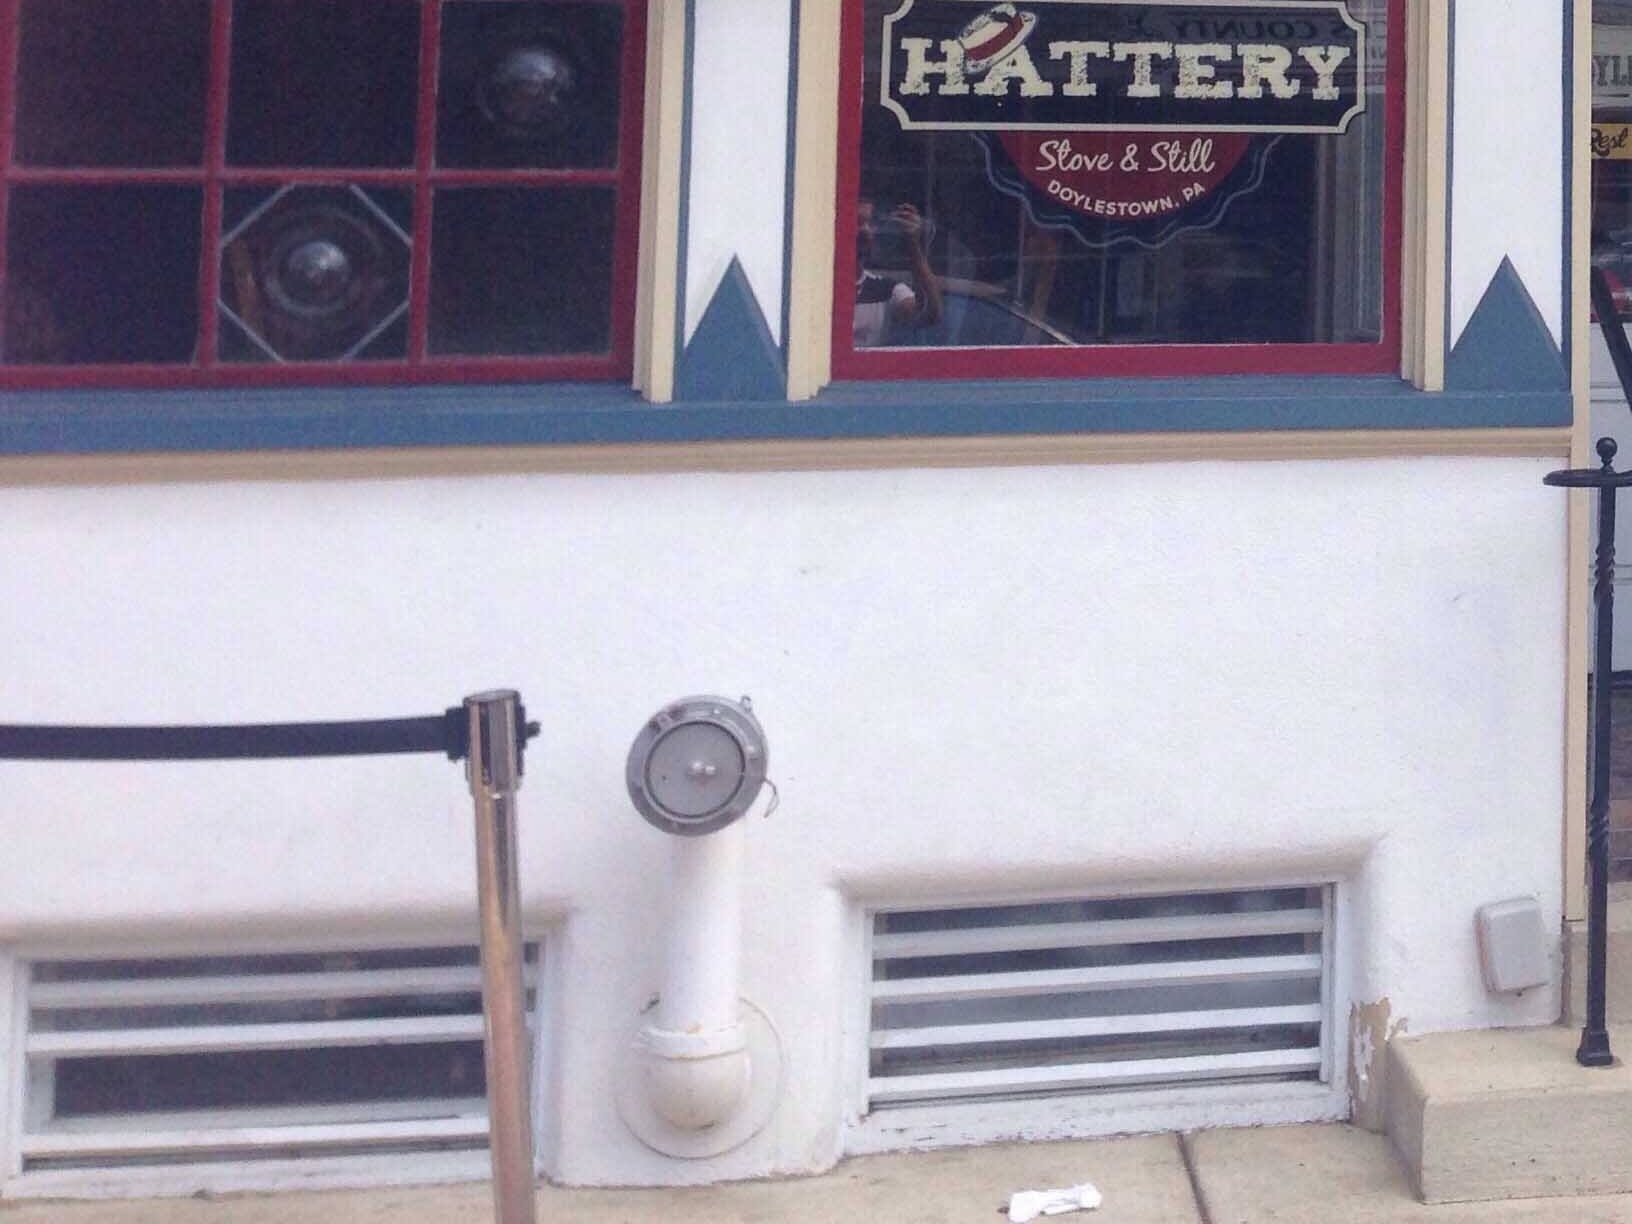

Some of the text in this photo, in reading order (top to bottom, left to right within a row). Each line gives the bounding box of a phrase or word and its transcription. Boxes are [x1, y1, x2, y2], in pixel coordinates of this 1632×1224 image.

[900, 37, 1351, 102] HATTERY
[1035, 138, 1216, 174] Stove & Still
[1591, 126, 1630, 158] Rest
[1182, 181, 1207, 202] PA
